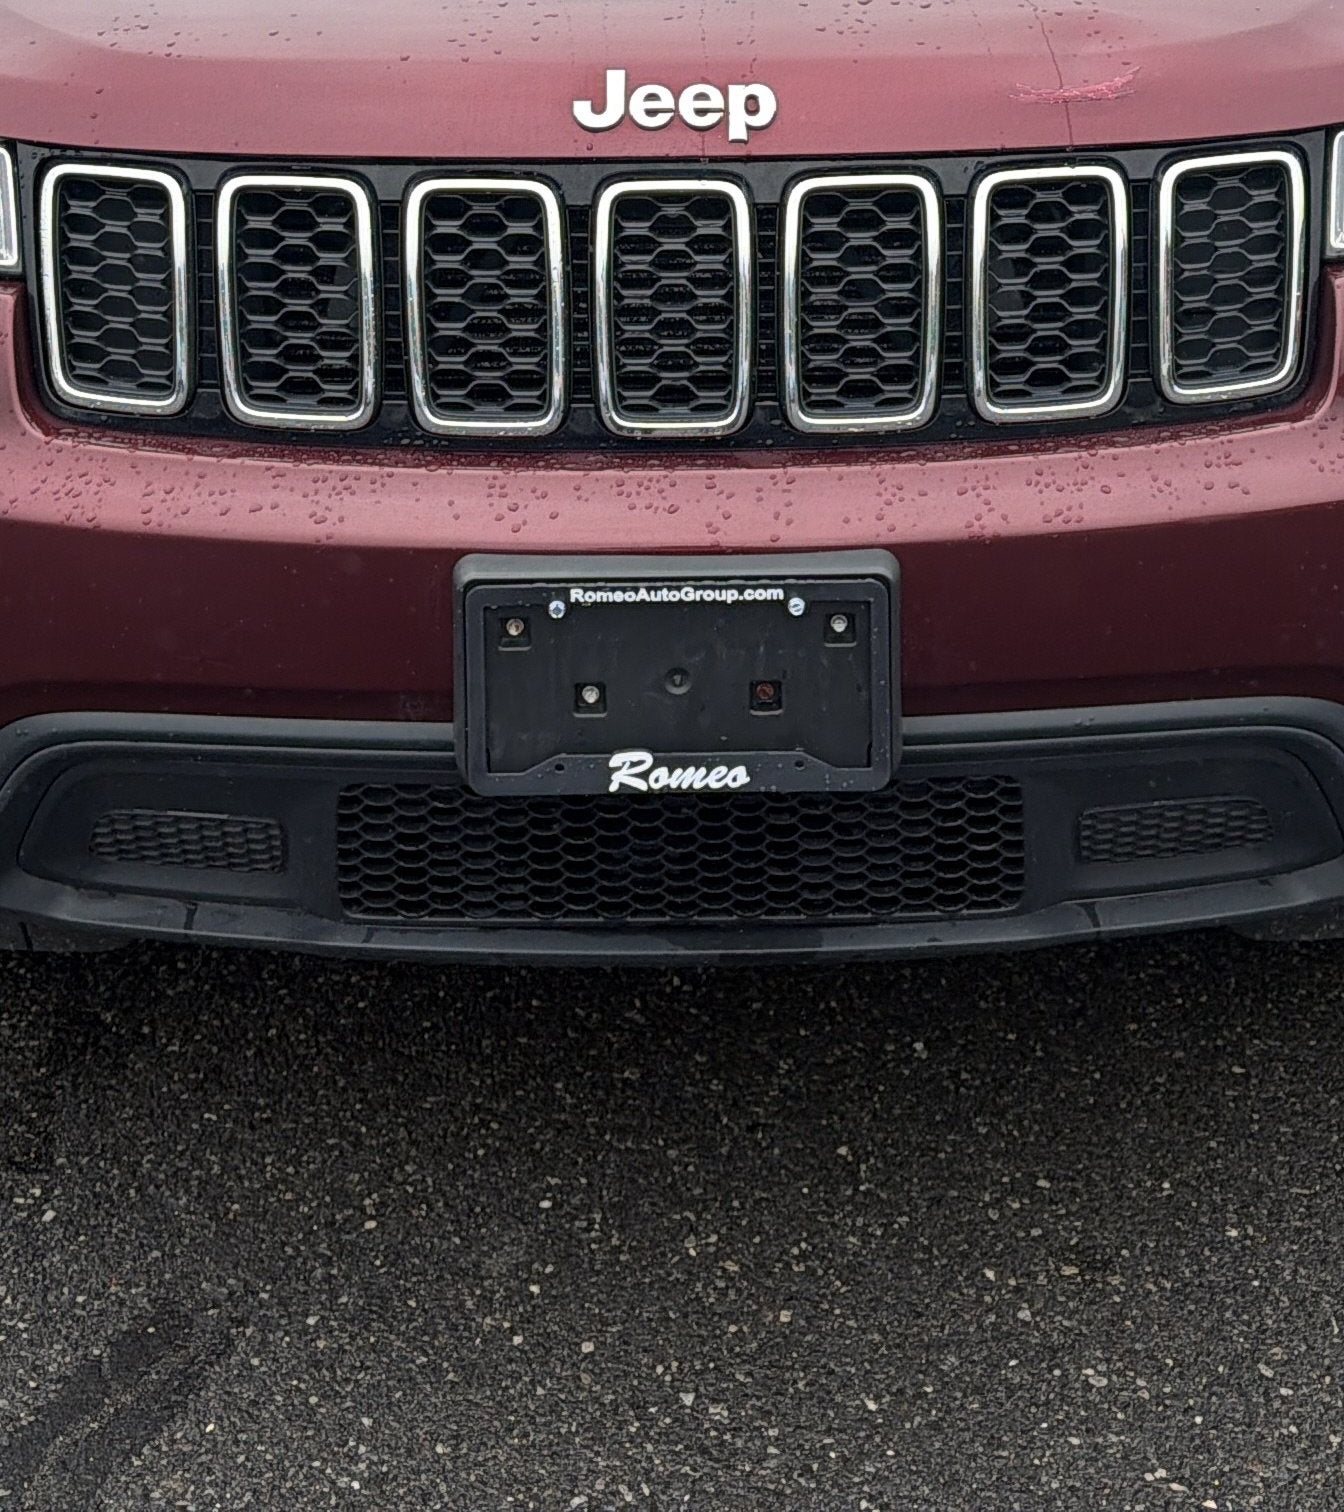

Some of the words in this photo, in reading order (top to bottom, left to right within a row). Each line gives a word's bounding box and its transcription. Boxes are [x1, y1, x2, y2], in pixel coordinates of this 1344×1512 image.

[572, 68, 778, 144] Jeep
[570, 587, 784, 604] RomeoAutoGroup.com
[607, 750, 751, 793] Romeo
